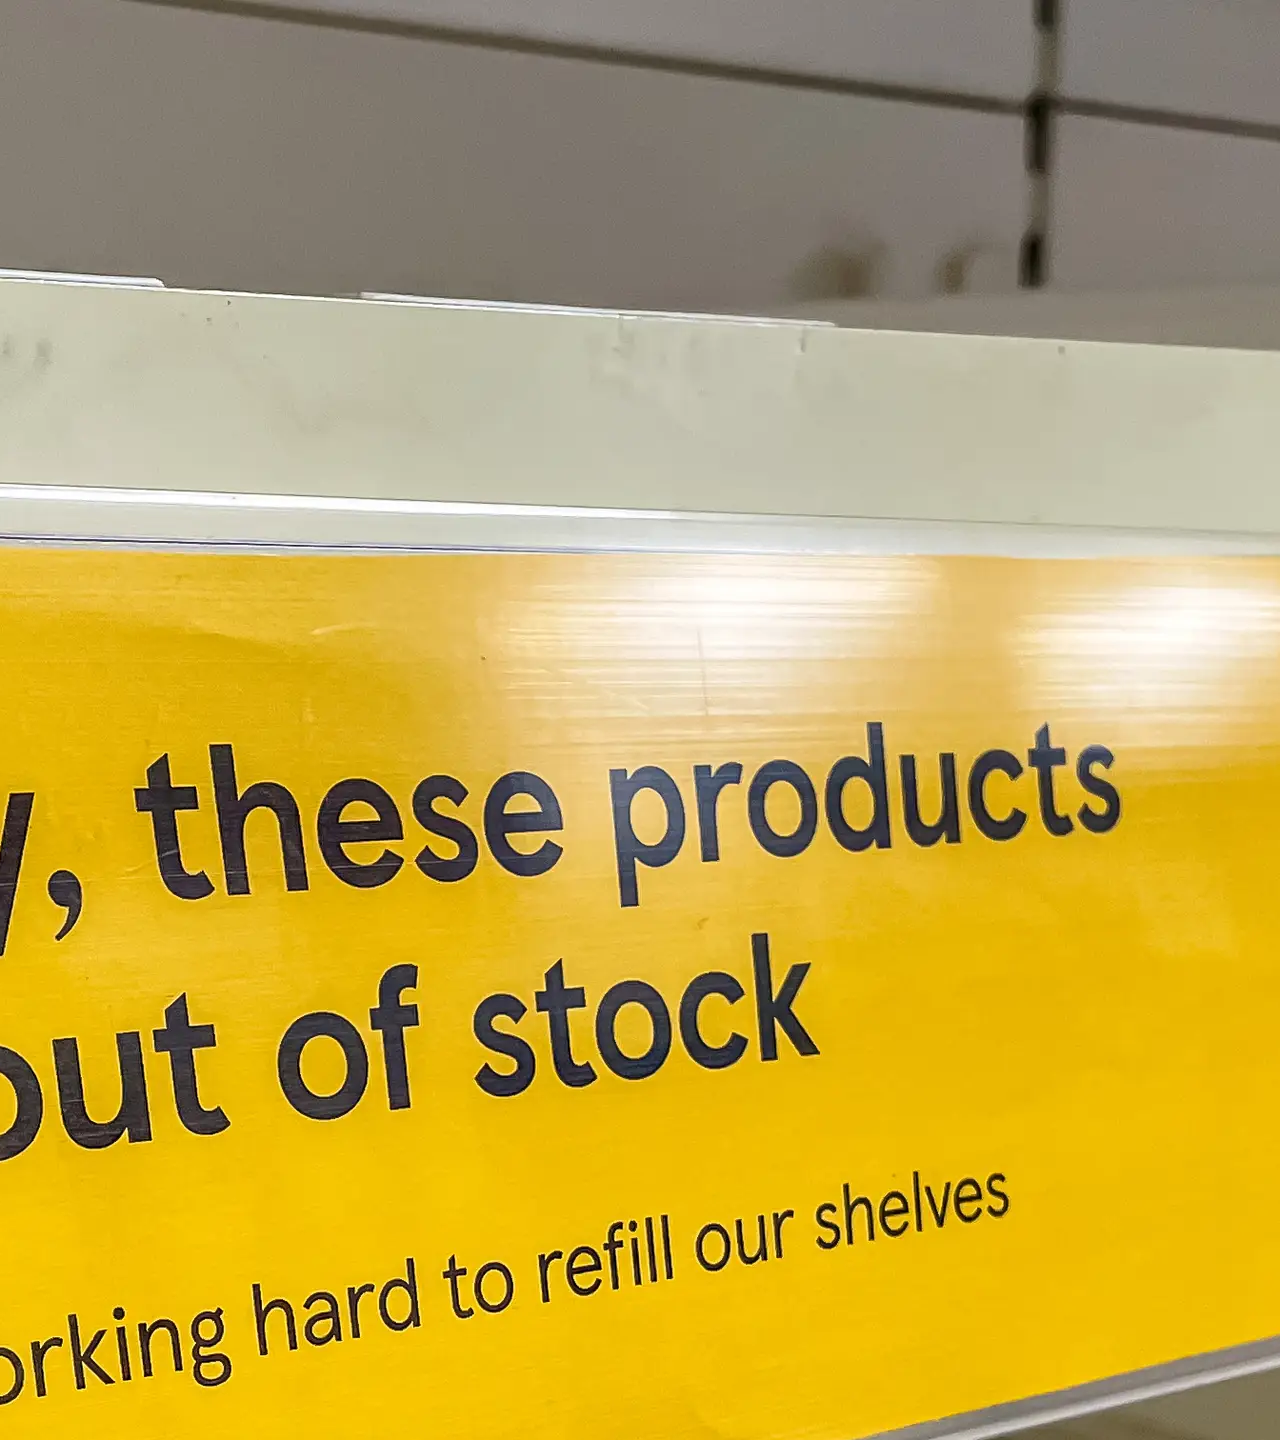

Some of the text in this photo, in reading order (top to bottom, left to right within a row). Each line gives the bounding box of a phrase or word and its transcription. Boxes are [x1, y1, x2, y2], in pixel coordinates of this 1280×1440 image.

[134, 744, 563, 900] these
[610, 722, 1122, 907] products
[278, 964, 419, 1120] of
[474, 933, 820, 1097] stock
[252, 1258, 422, 1355] hard
[442, 1251, 514, 1318] to
[538, 1214, 674, 1303] refill
[696, 1209, 795, 1271] our
[815, 1171, 1010, 1249] shelves
